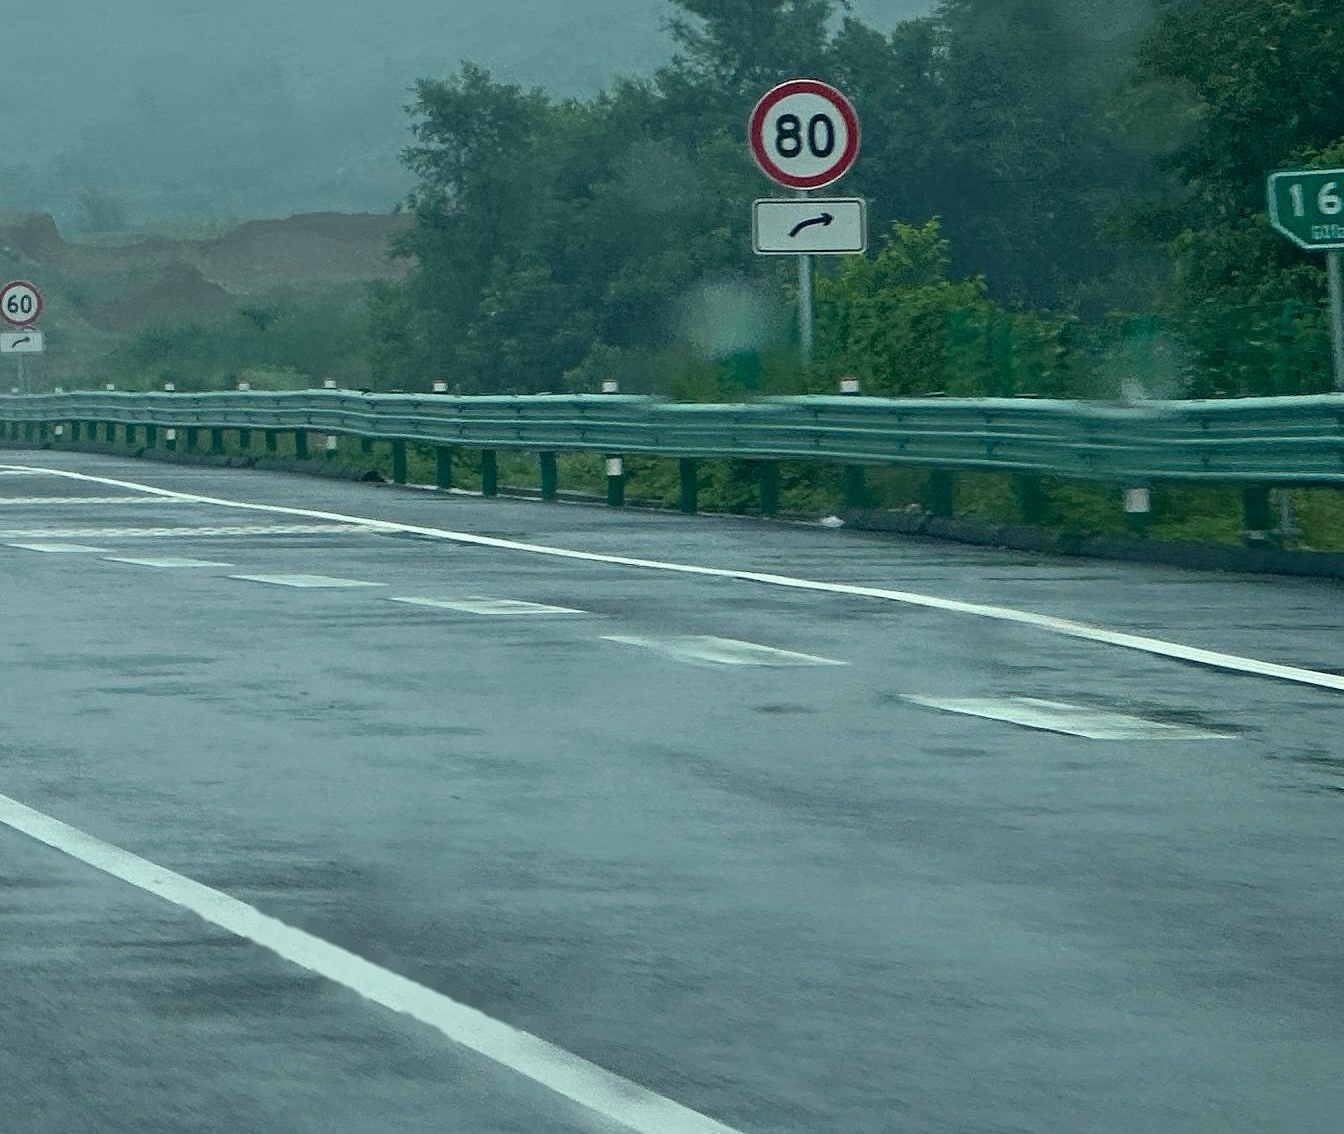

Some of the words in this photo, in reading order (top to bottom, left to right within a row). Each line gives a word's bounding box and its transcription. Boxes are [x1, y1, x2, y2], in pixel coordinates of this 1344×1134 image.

[775, 113, 835, 158] 80
[1288, 181, 1343, 217] 16
[7, 294, 32, 314] 60
